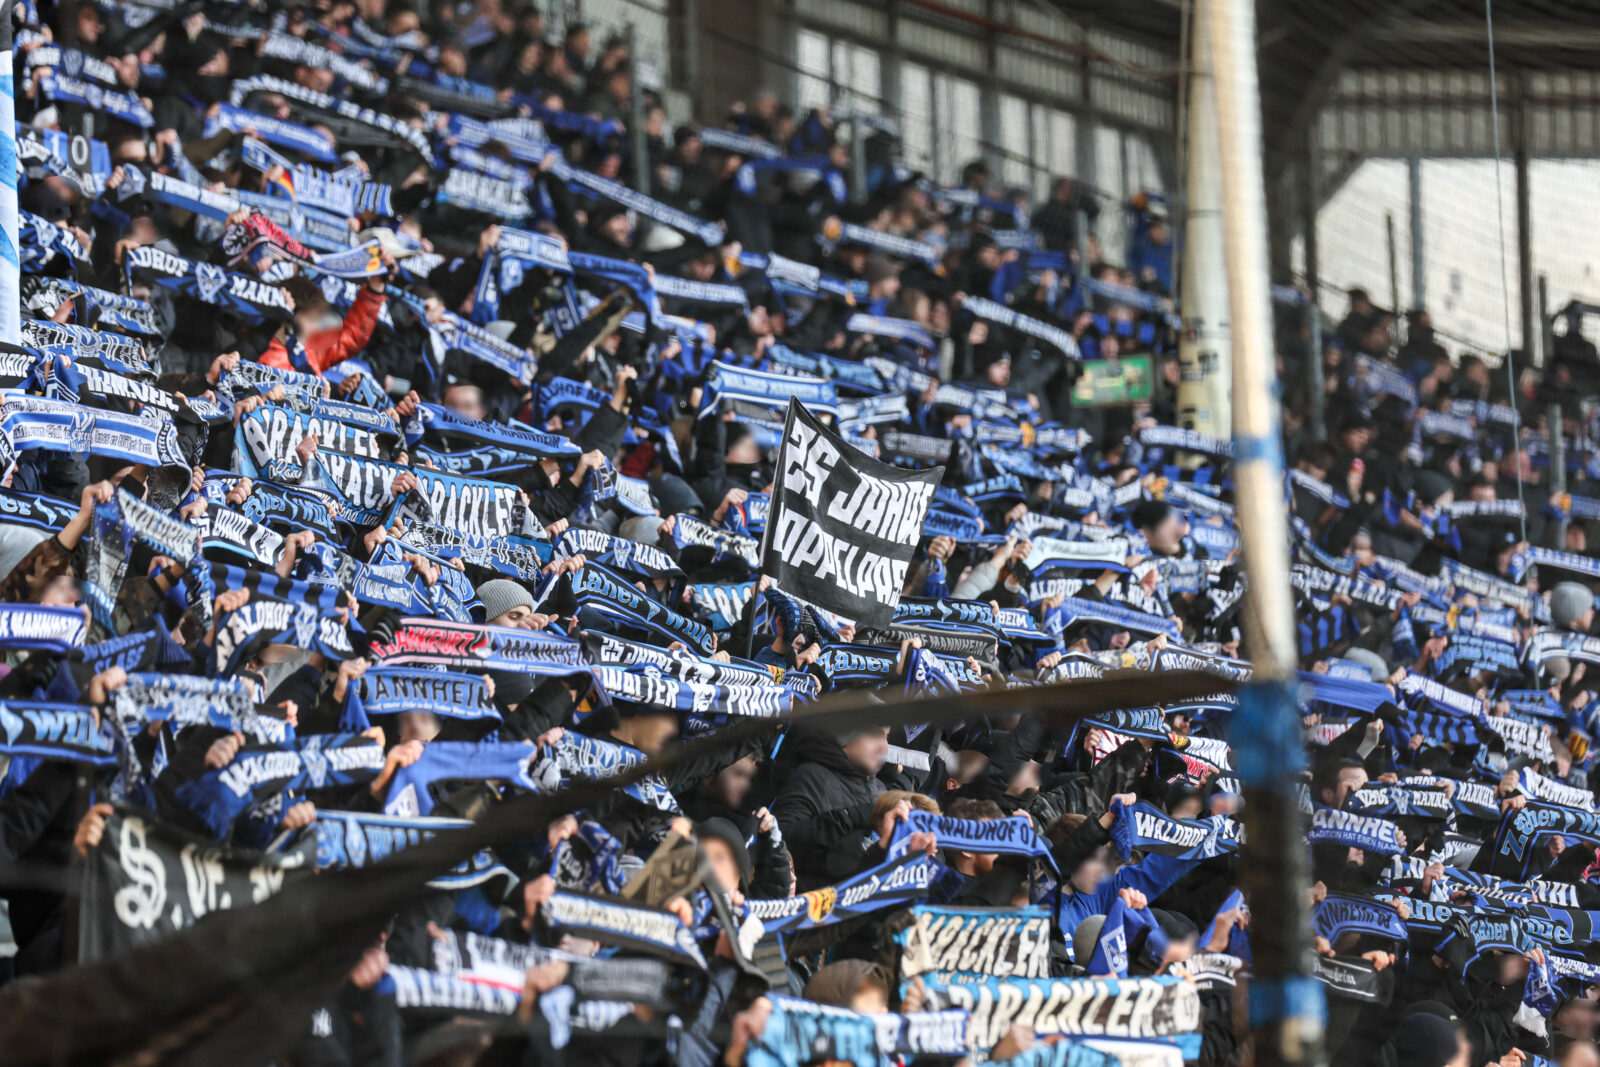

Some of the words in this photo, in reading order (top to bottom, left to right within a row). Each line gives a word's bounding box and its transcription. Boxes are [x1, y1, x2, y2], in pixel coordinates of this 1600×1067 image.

[784, 416, 841, 509] 25
[930, 634, 988, 657] MANNHEIM
[602, 667, 680, 709] WALTER
[938, 816, 1017, 842] WALDHOF
[1135, 811, 1208, 847] WALDHOF
